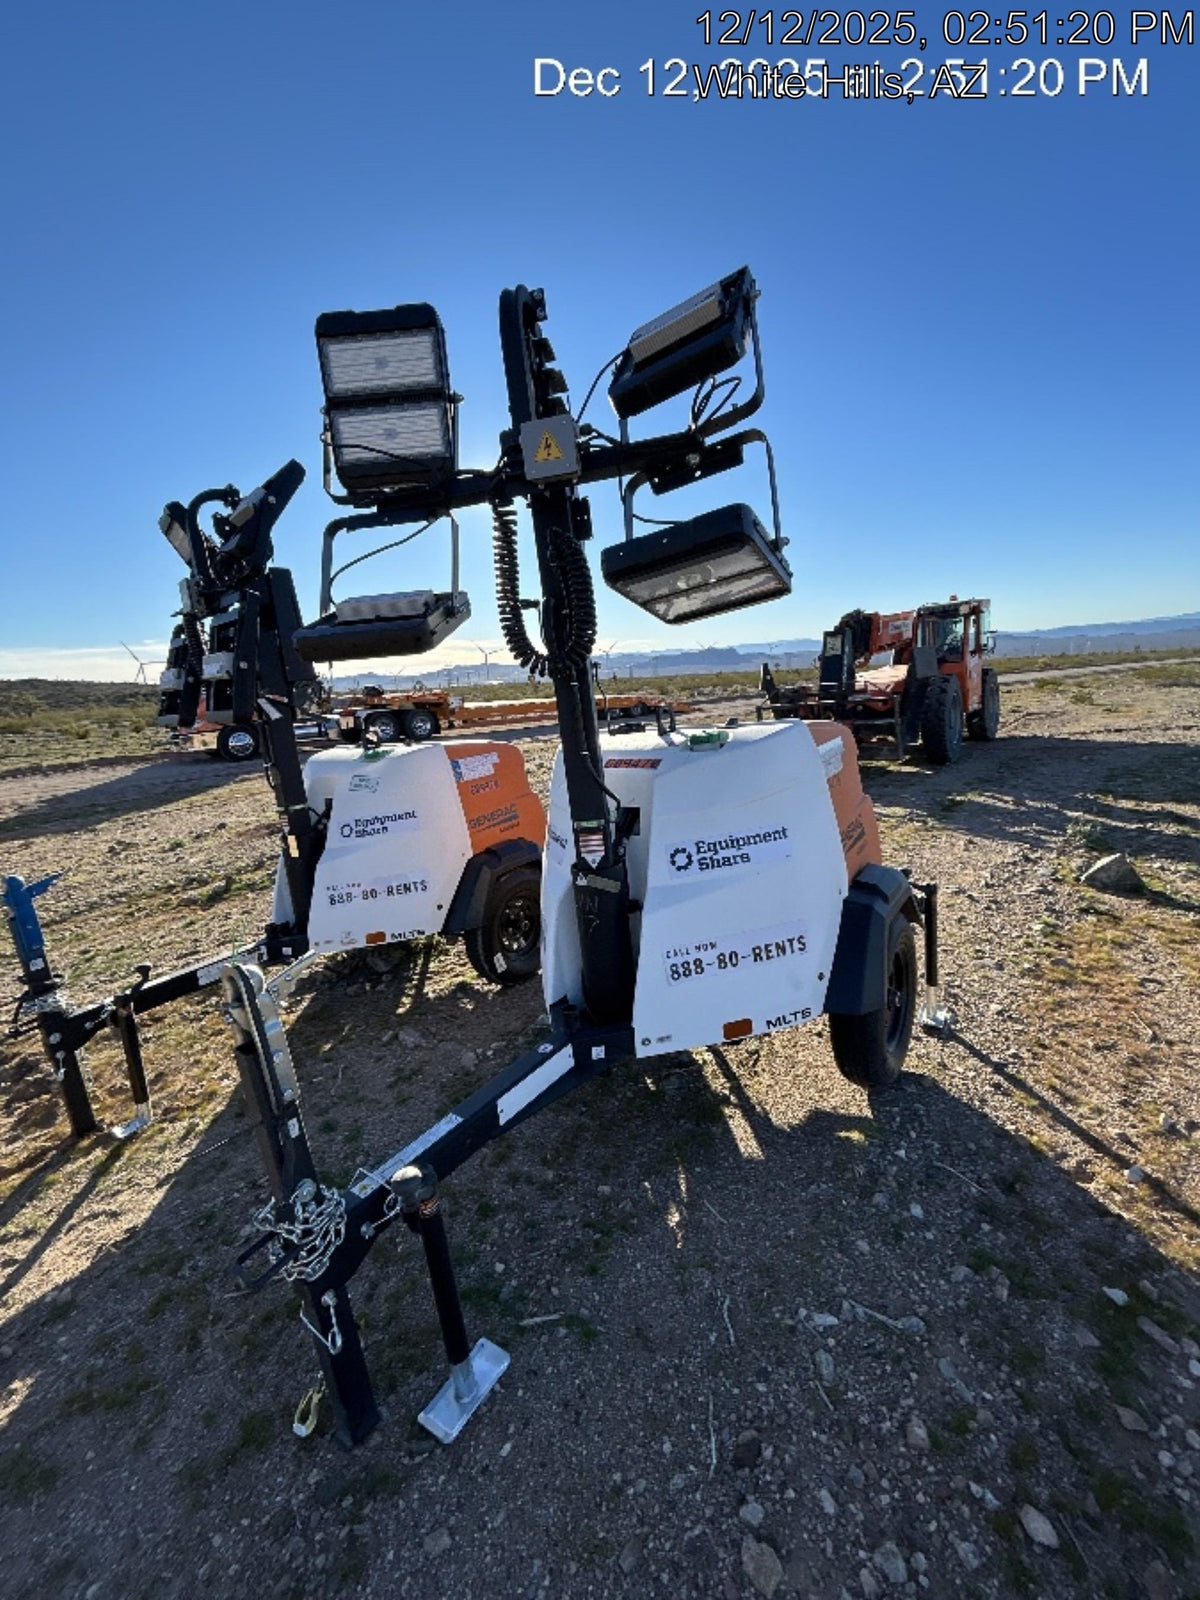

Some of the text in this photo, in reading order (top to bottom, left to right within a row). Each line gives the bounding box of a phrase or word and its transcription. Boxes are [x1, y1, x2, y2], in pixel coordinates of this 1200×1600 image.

[695, 826, 788, 855] Equipment
[697, 853, 751, 872] Share
[666, 941, 717, 960] CALL NOW
[669, 935, 807, 981] 888-80-RENTS
